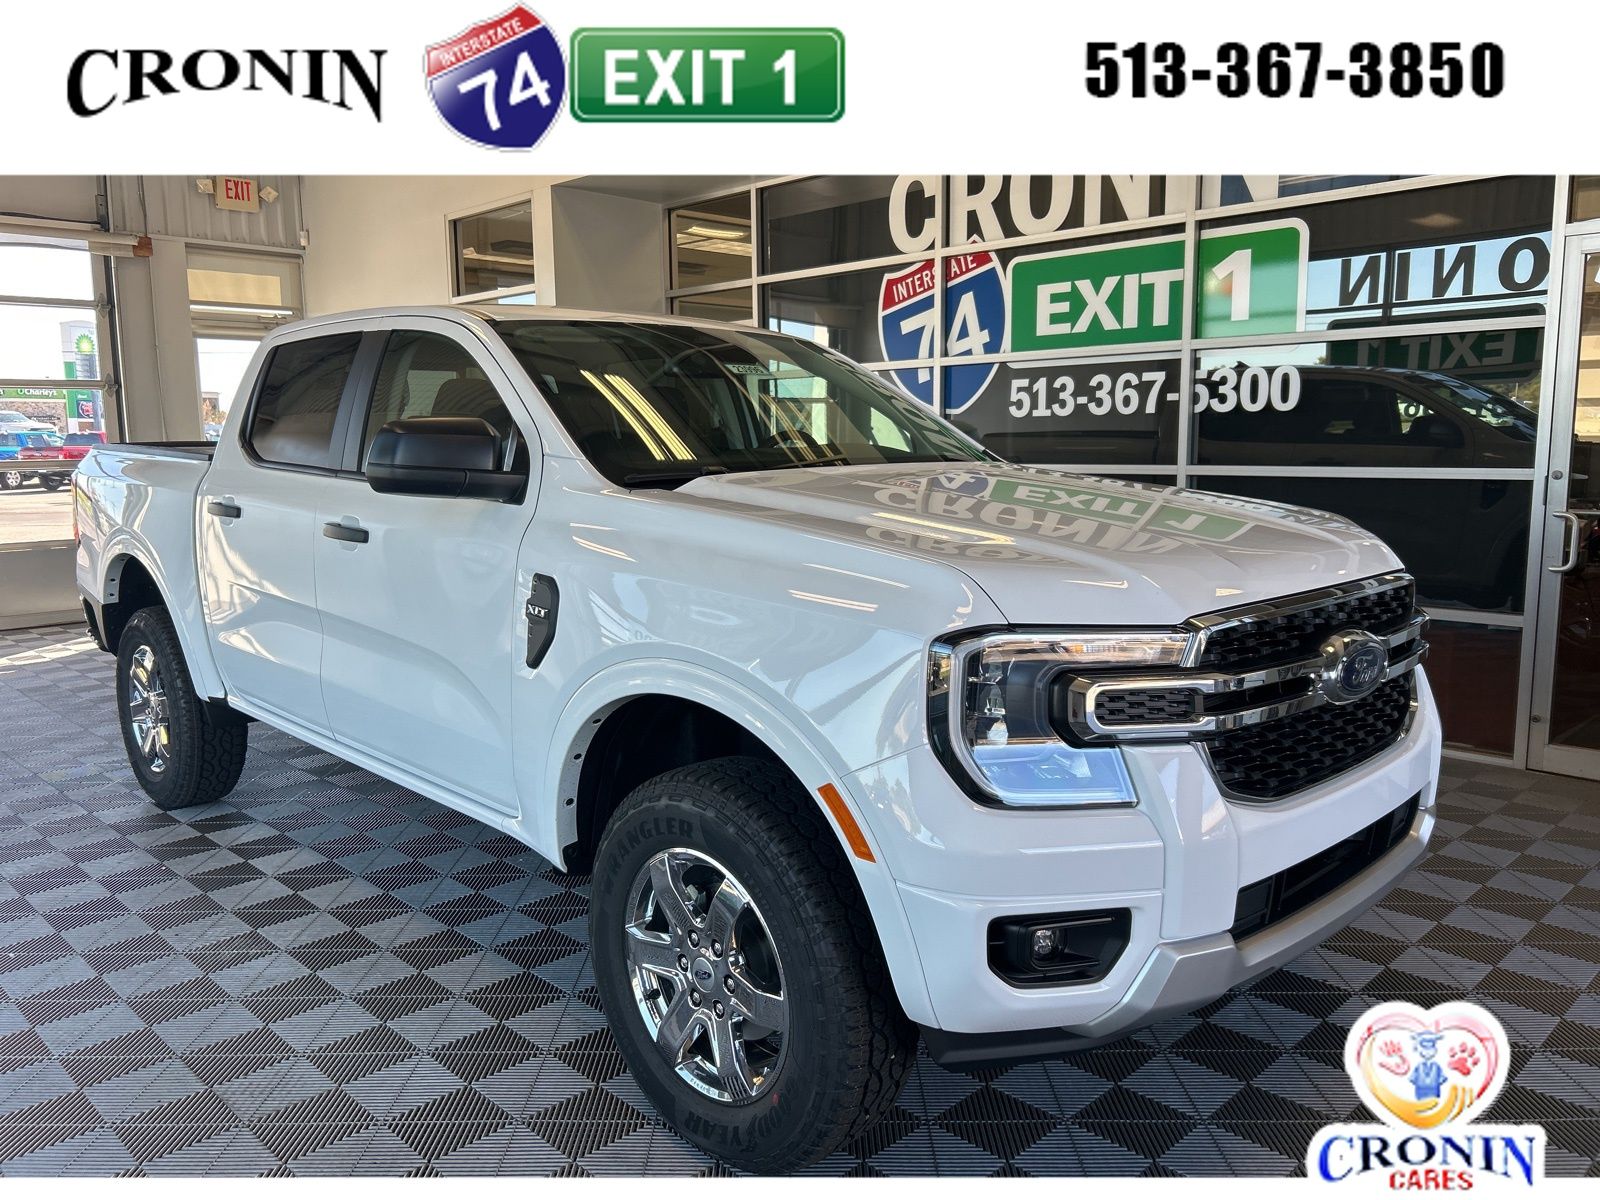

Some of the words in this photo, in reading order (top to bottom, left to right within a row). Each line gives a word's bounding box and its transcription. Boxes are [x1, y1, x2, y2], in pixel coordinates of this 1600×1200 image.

[225, 178, 251, 202] EXIT
[893, 252, 978, 303] INTERATE
[1035, 268, 1184, 337] EXIT
[1211, 248, 1252, 322] 1
[900, 291, 990, 384] 74
[1008, 365, 1301, 418] 513-367-5300
